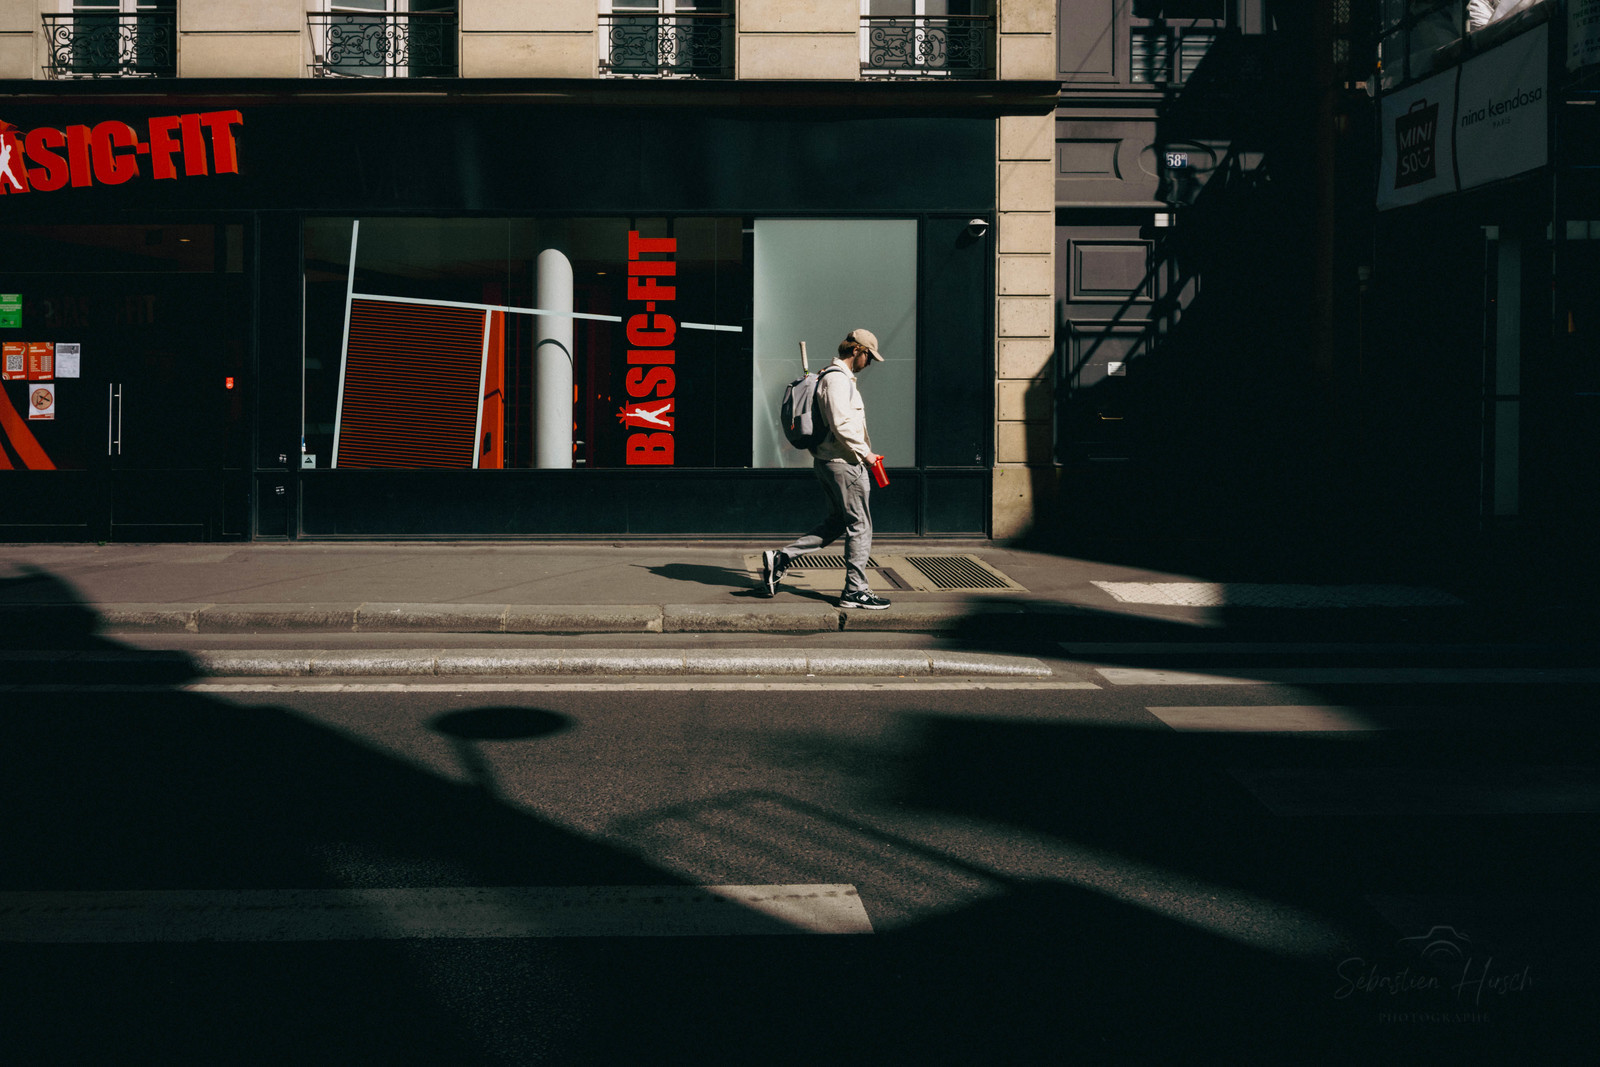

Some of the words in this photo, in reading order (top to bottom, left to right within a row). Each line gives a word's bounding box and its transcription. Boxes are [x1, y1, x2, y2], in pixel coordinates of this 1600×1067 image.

[1462, 109, 1485, 127] nina
[1488, 87, 1542, 118] kendosa
[1400, 121, 1433, 151] MINI
[623, 230, 677, 465] BASIC-FIT
